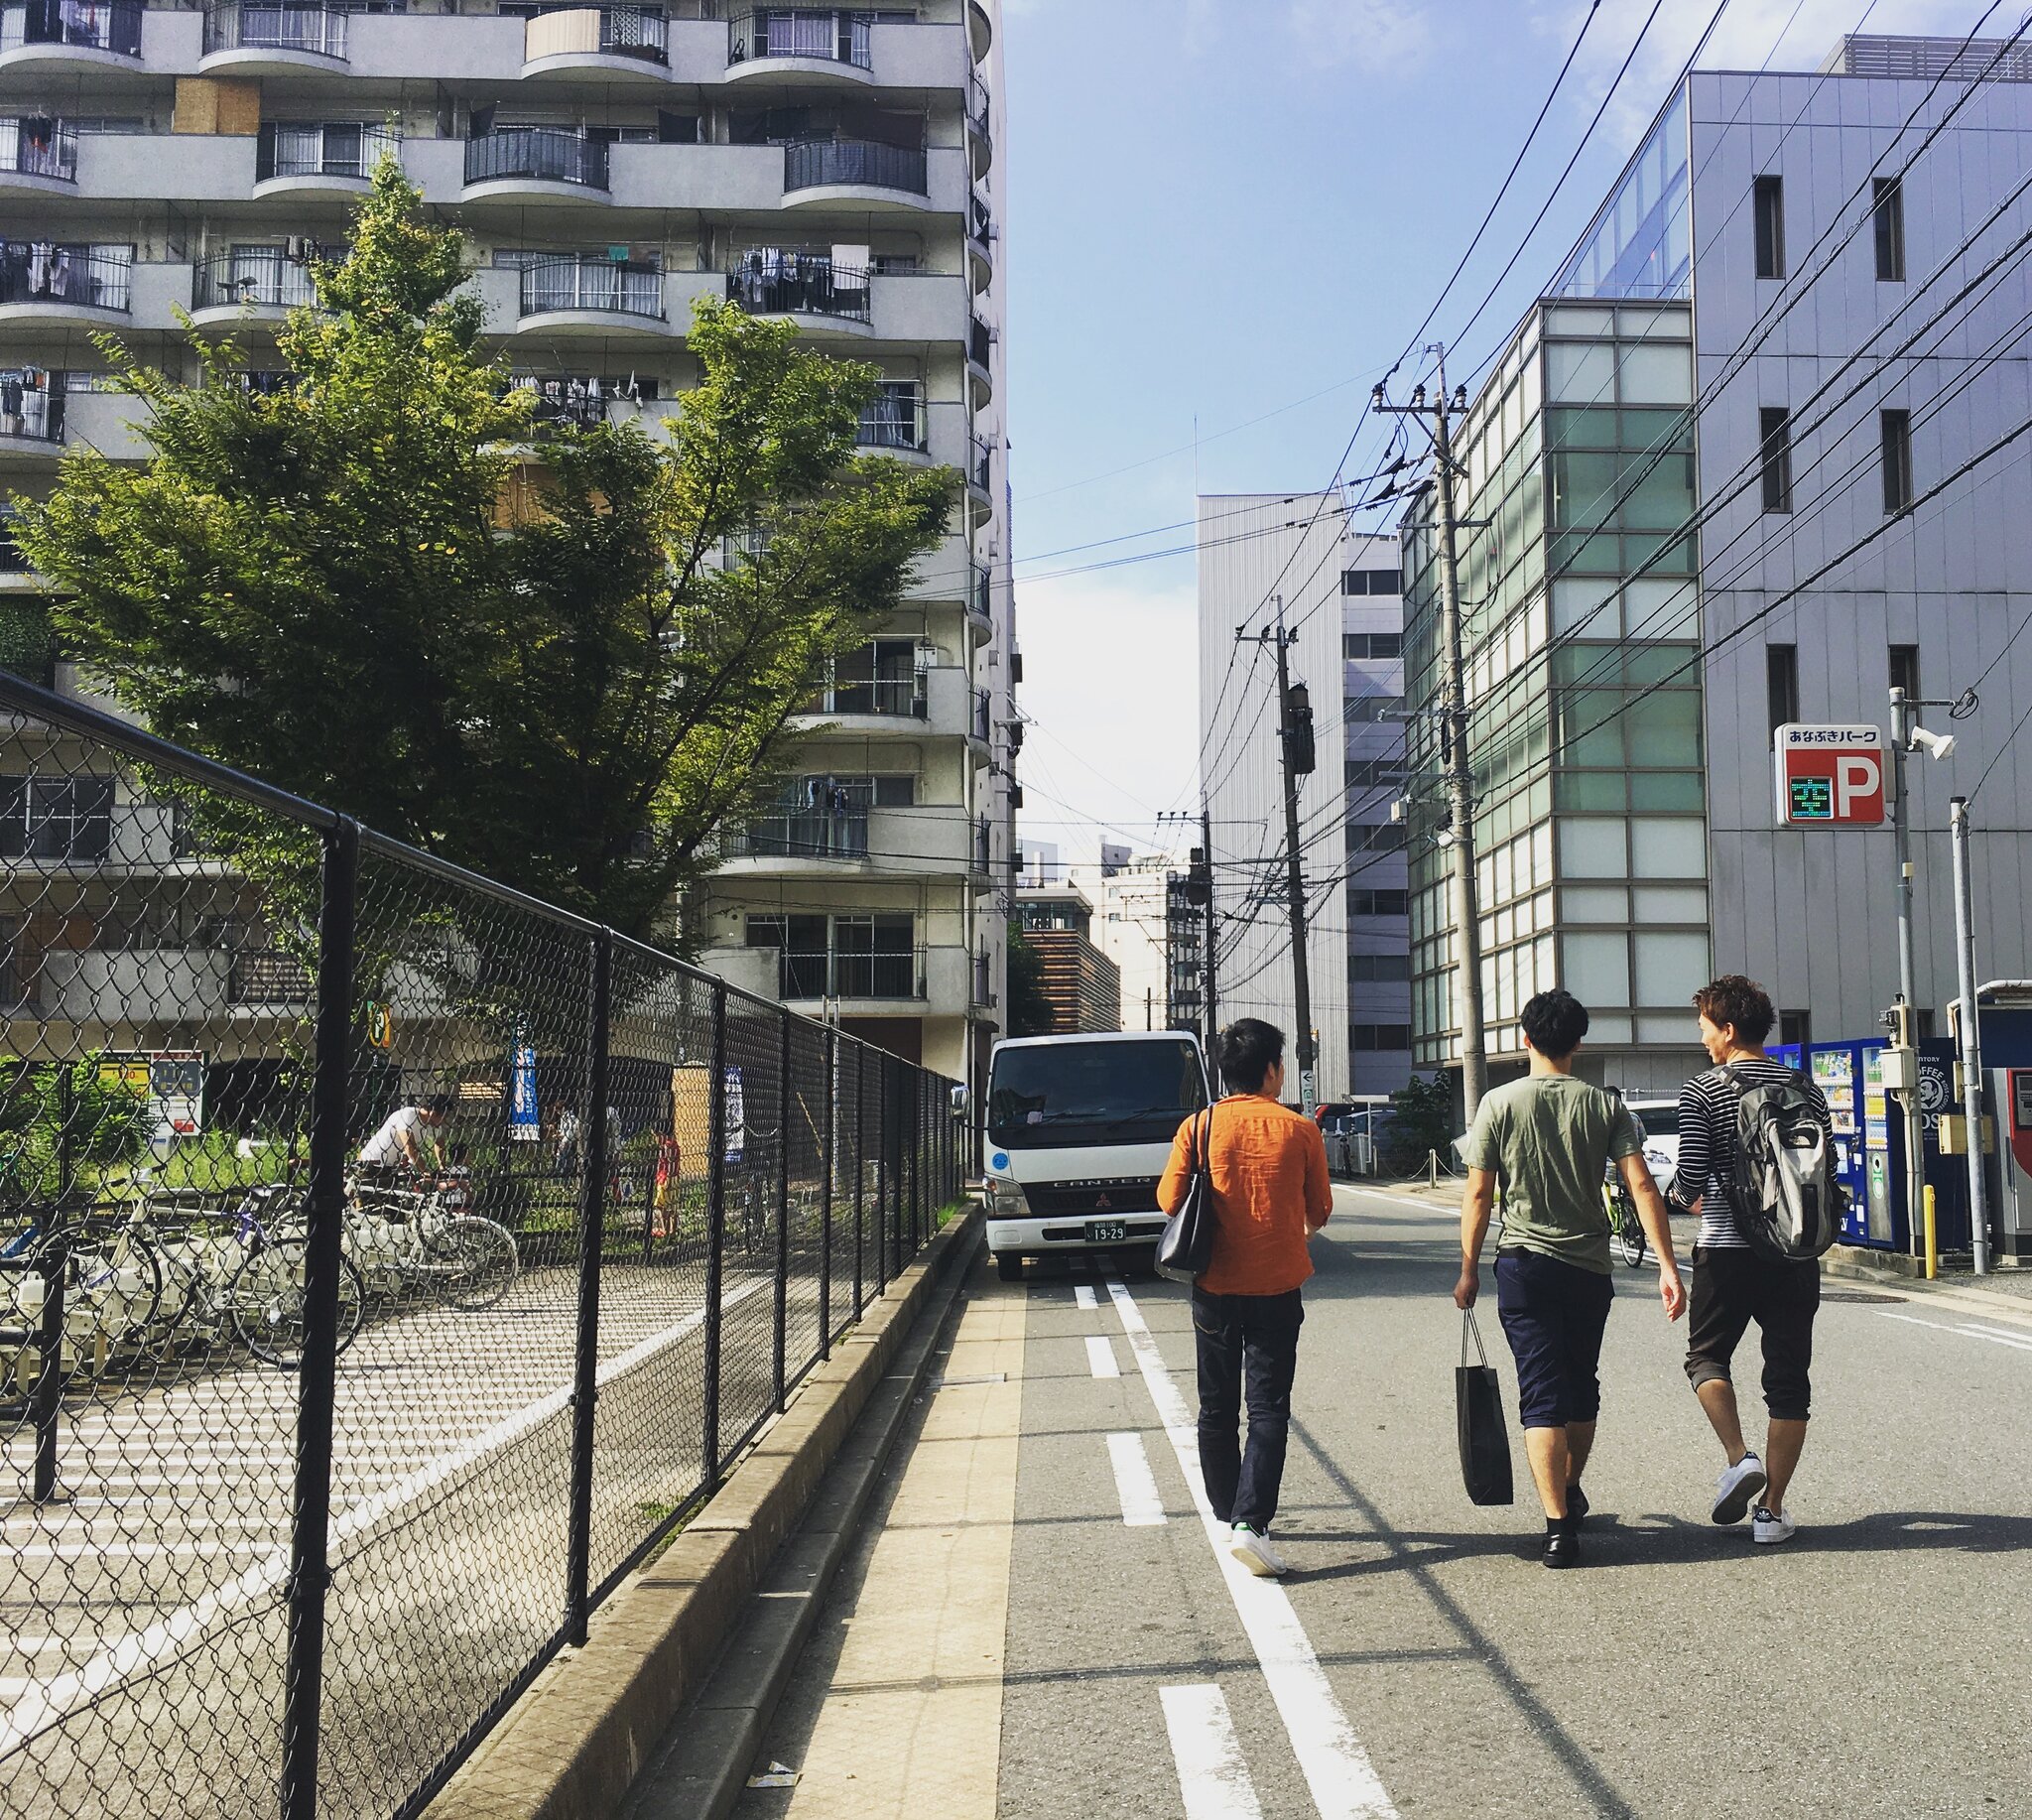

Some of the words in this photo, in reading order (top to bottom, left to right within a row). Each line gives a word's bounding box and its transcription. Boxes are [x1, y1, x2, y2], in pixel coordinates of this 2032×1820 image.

[1789, 730, 1877, 743] あなぶきパーク
[1837, 756, 1880, 818] P
[1791, 779, 1831, 817] 空
[1919, 1066, 1945, 1081] FFEE
[1054, 1177, 1151, 1188] CANTER
[1094, 1228, 1124, 1240] 19-29
